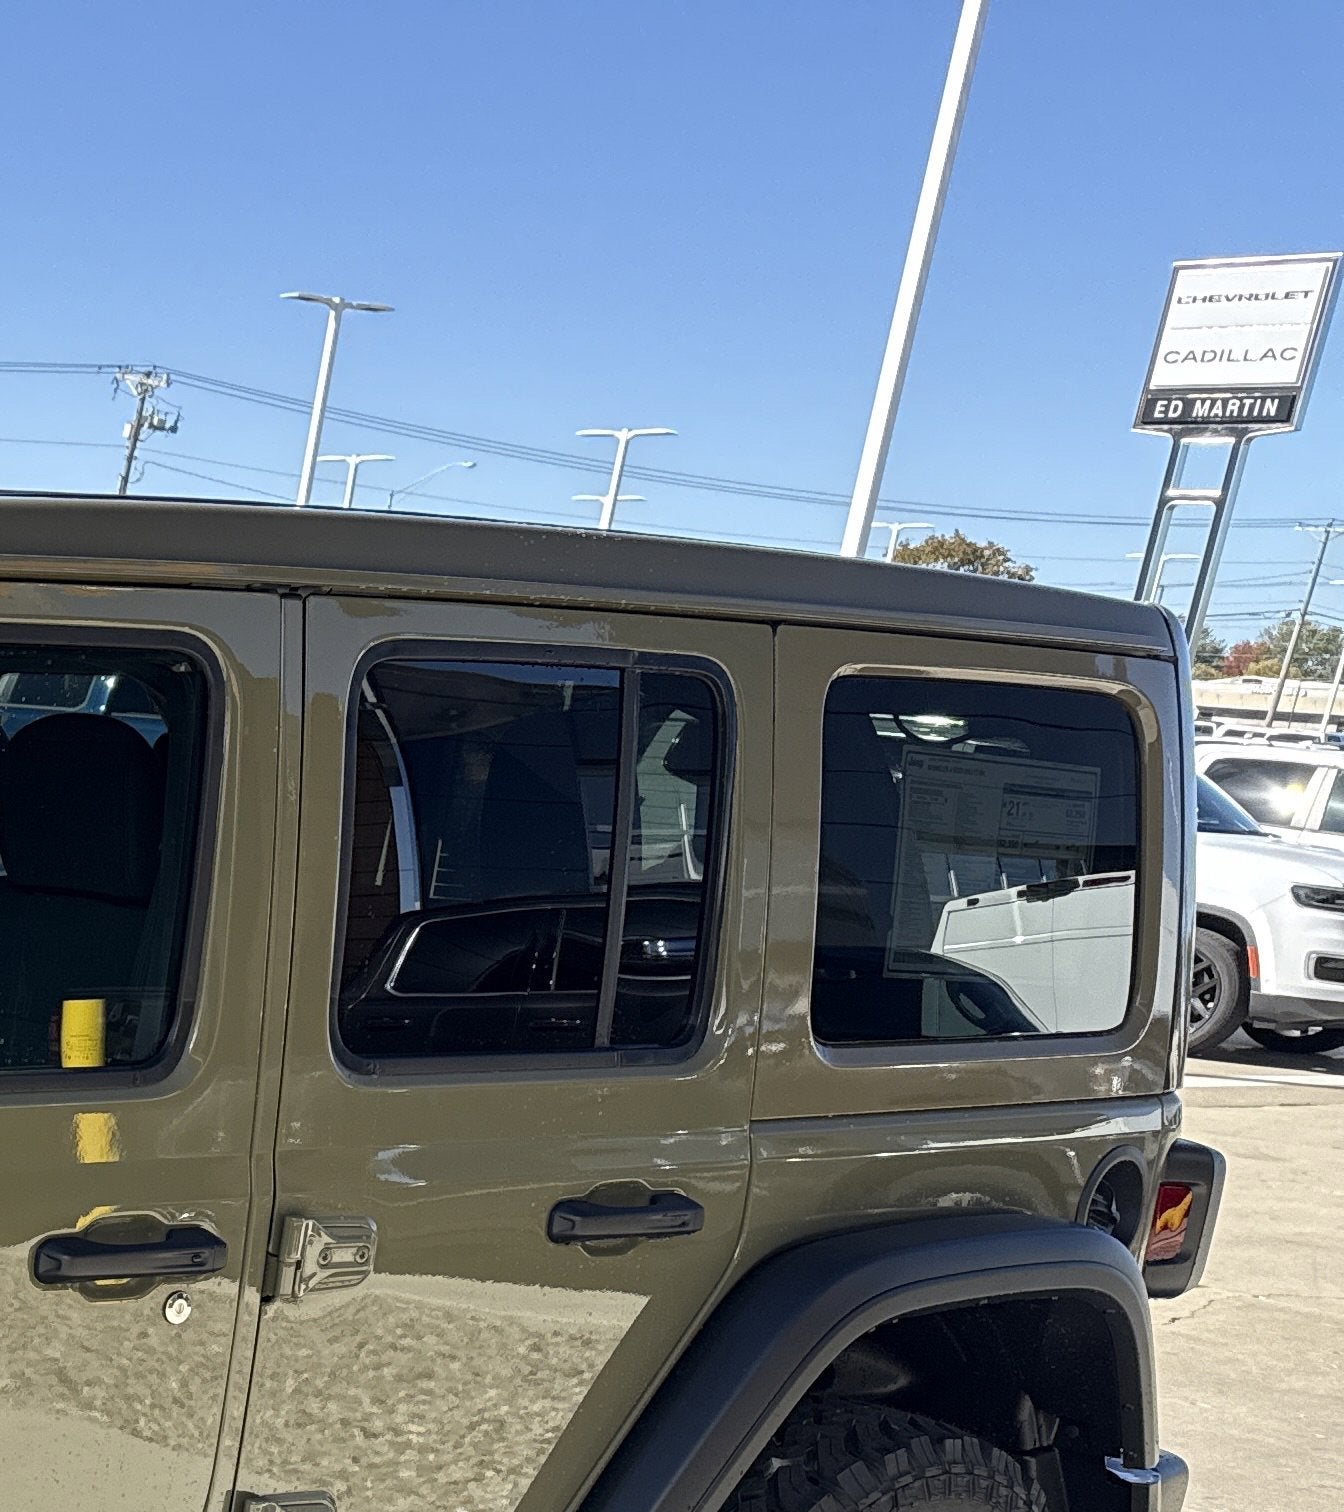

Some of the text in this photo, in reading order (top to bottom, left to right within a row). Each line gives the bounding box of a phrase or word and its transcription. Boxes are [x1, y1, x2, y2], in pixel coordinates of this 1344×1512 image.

[1177, 290, 1315, 305] CHEVROLET
[1163, 347, 1299, 364] CADILLAC
[1153, 398, 1280, 418] ED MARTIN
